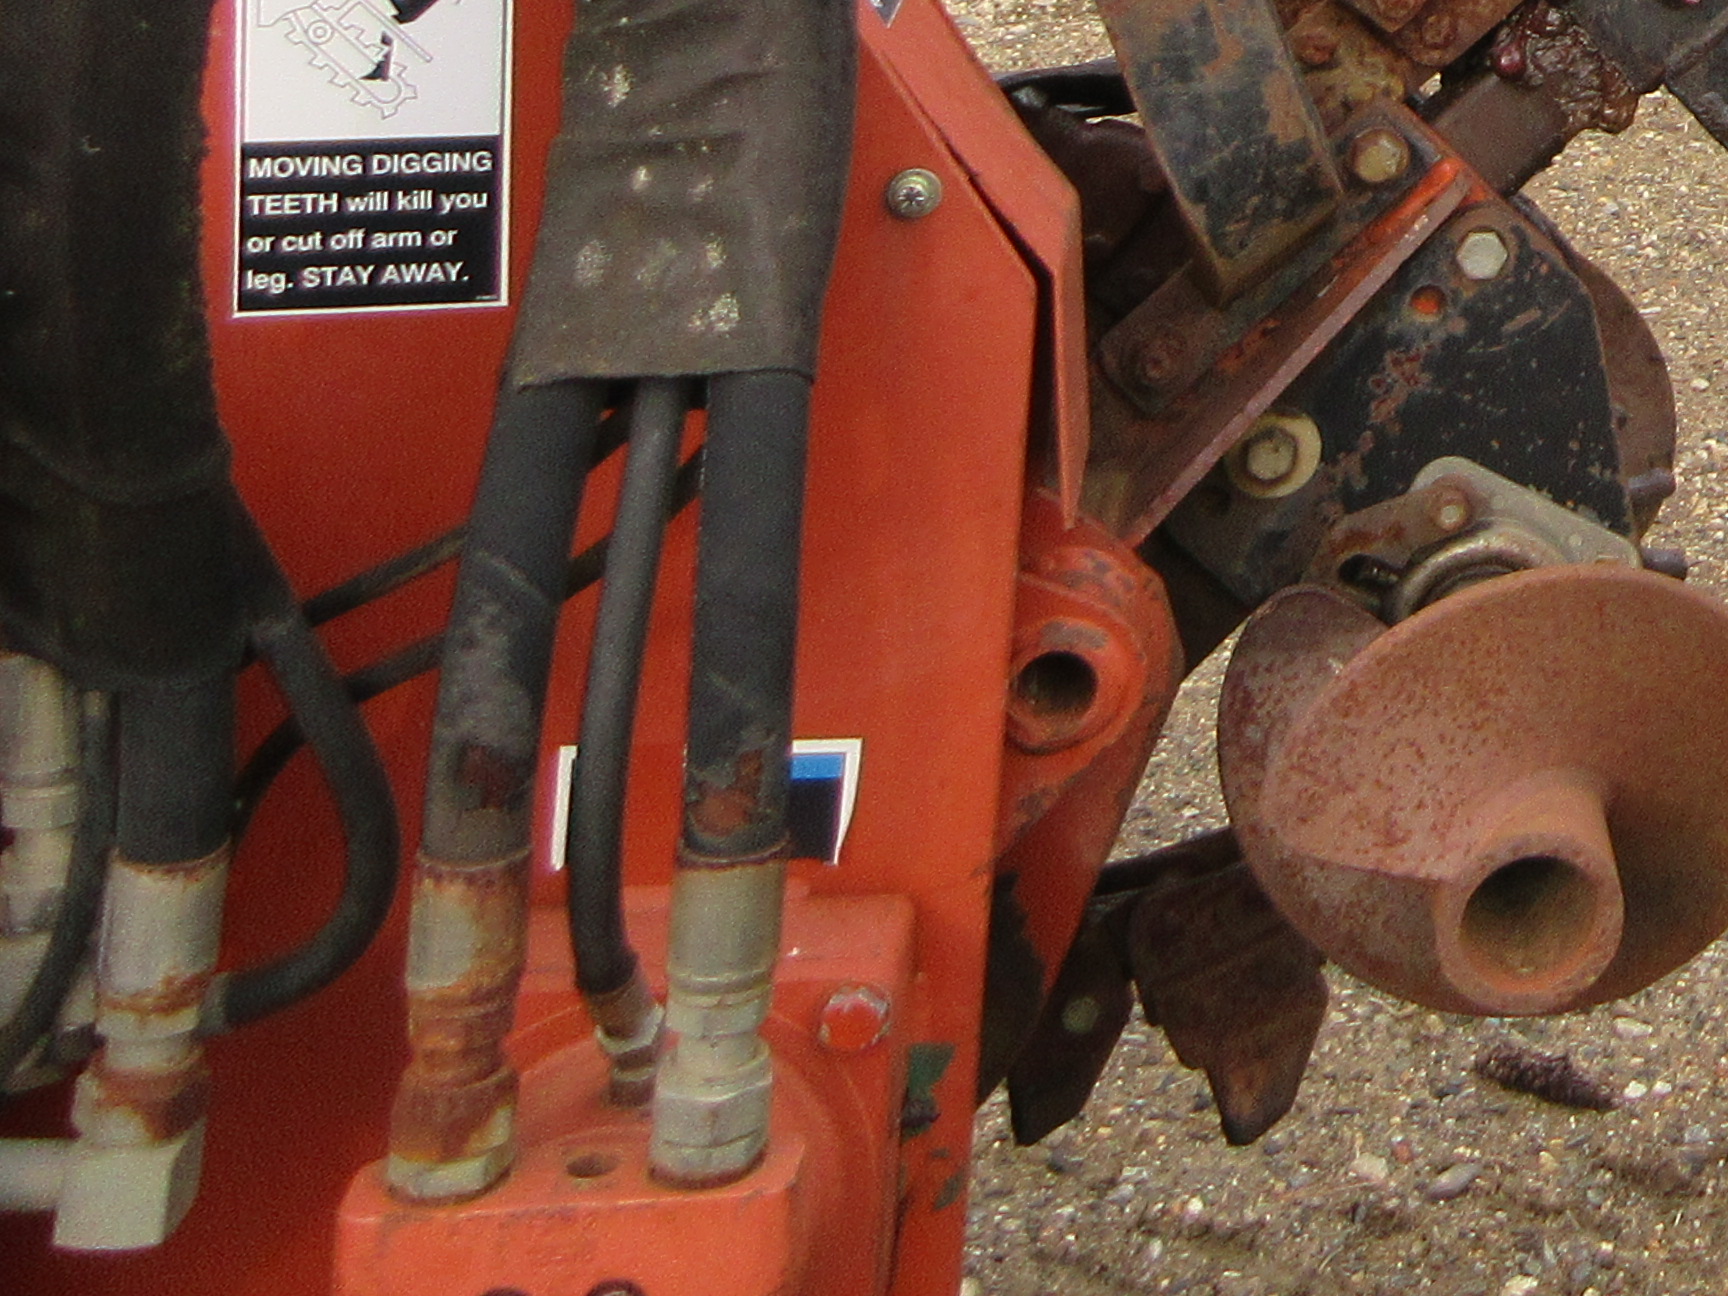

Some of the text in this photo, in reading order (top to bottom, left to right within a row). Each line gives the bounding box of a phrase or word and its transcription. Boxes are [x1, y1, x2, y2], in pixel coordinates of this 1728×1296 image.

[248, 150, 493, 178] MOVING DIGGING
[247, 189, 488, 215] TEETH will kill you
[246, 227, 459, 253] or cut off arm or
[246, 261, 471, 294] leg. STAY AWAY.
